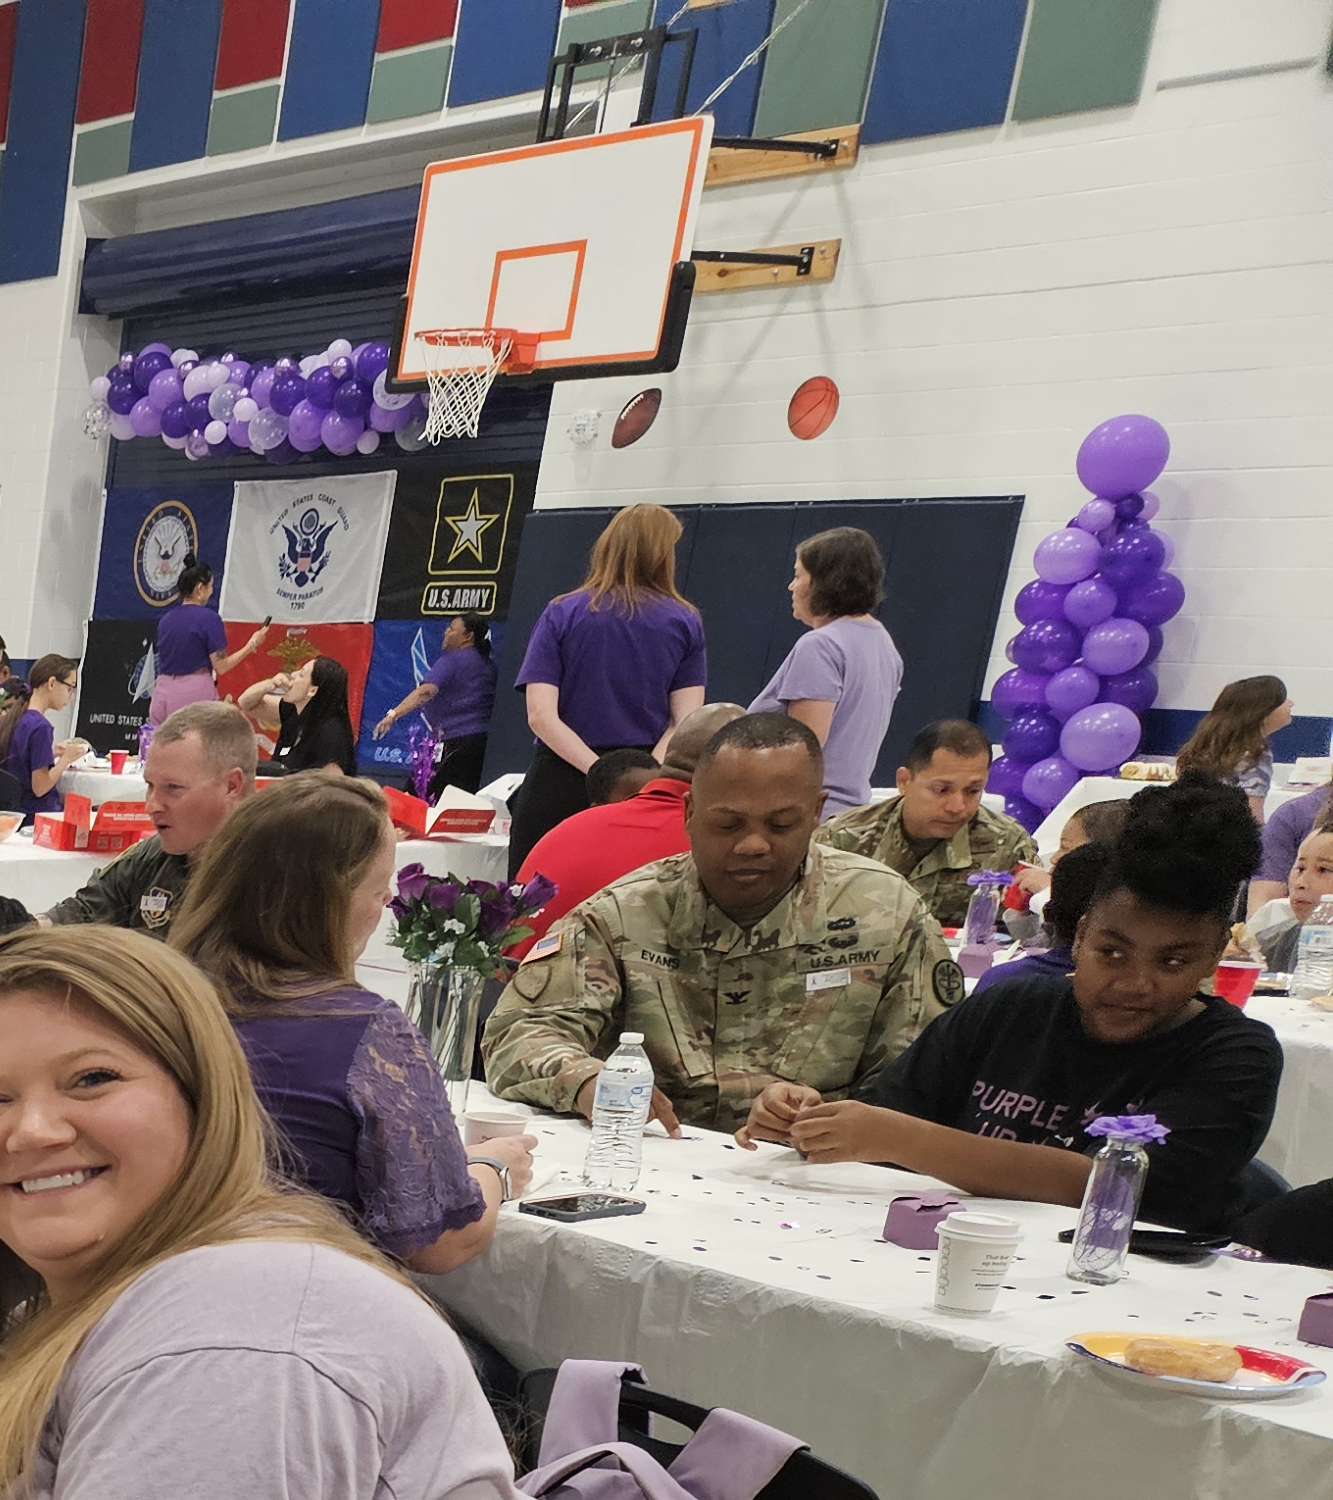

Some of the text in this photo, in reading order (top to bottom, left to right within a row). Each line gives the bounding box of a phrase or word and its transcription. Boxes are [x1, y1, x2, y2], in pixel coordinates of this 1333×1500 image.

[318, 493, 337, 507] COAST
[89, 713, 115, 724] UNITED
[117, 715, 143, 726] STATES
[641, 949, 680, 969] EVANS
[971, 1080, 1071, 1131] PURPLE
